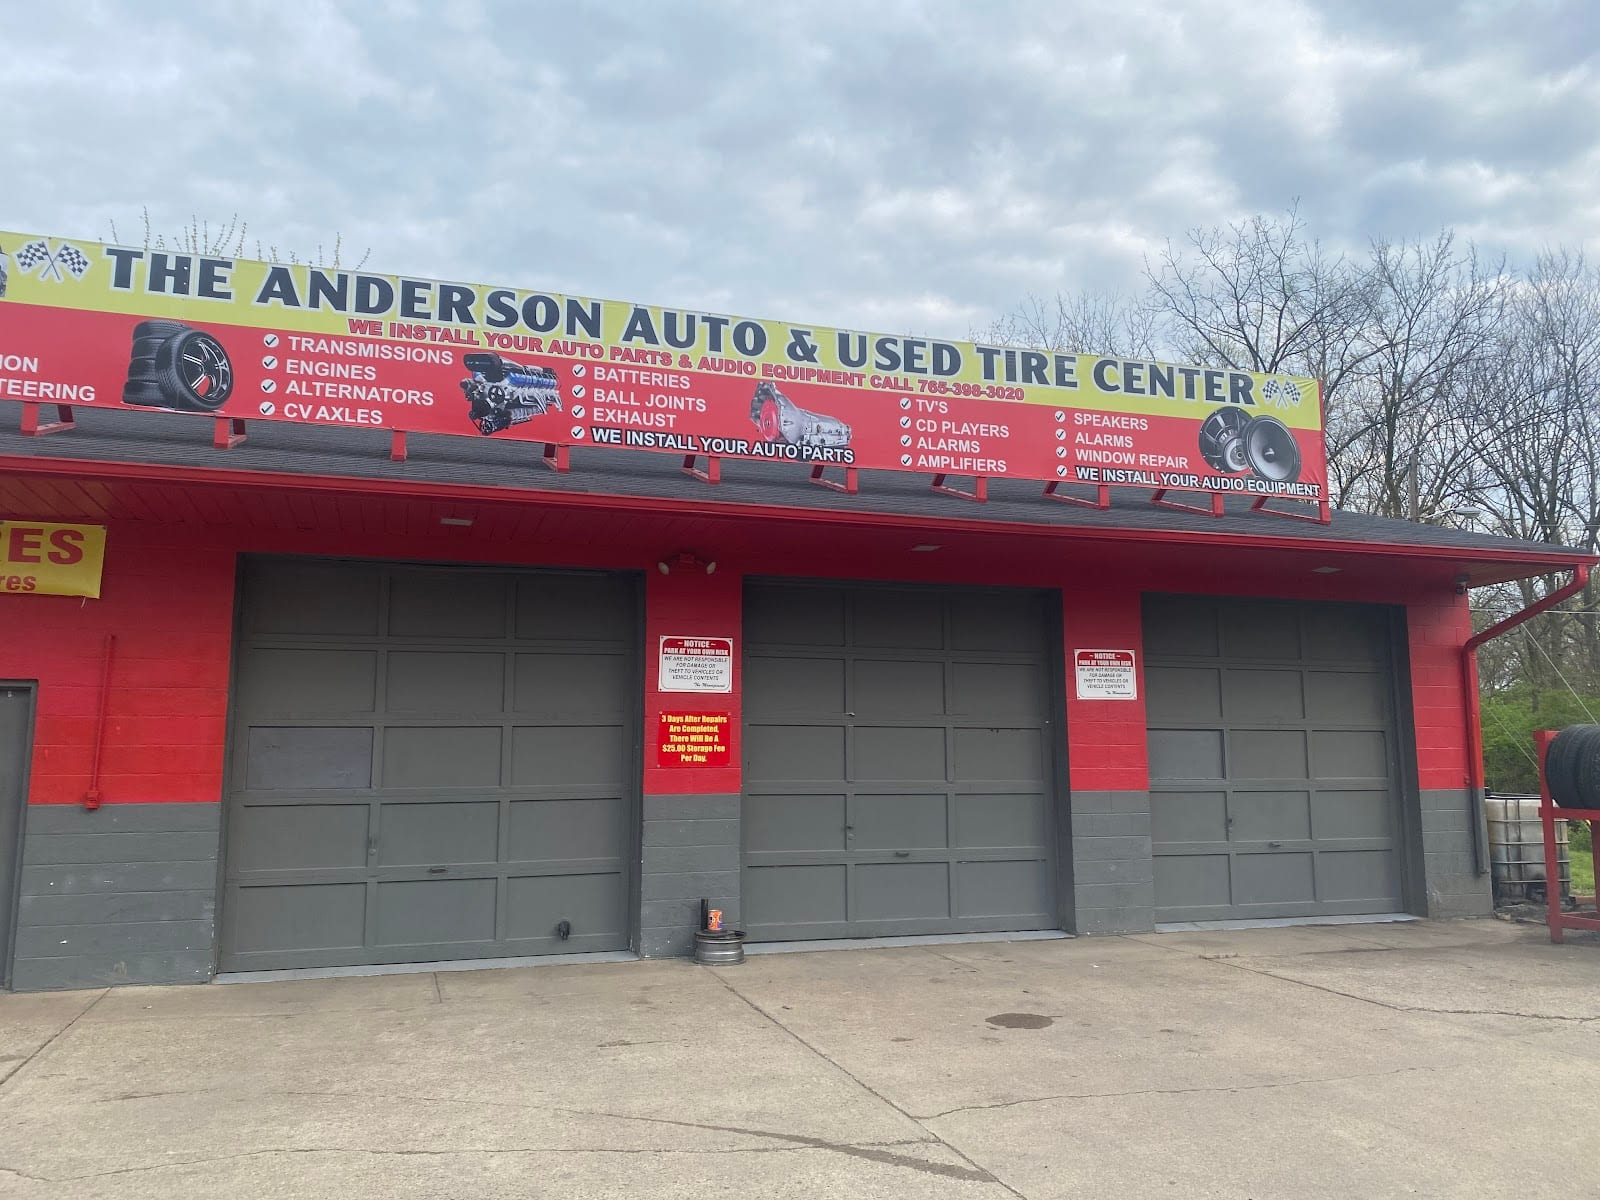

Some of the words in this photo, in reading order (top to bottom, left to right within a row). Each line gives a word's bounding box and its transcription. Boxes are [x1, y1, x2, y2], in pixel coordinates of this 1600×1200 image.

[106, 247, 233, 300] THE
[255, 266, 601, 339] ANDERSON
[622, 308, 767, 356] AUTO
[787, 329, 818, 363] &
[838, 332, 961, 377] USED
[977, 346, 1078, 389] TIRE
[1094, 359, 1255, 405] CENTER
[287, 335, 454, 365] TRANSMISSIONS
[348, 318, 383, 336] WE
[389, 322, 479, 346] INSTALL
[483, 331, 543, 353] YOUR
[549, 339, 604, 359] AUTO
[610, 346, 673, 367] PARTS
[678, 354, 693, 369] &
[698, 356, 757, 375] AUDIO
[762, 363, 866, 387] EQUIPMENT
[870, 374, 914, 392] CALL
[917, 379, 1025, 401] 765-398-3020
[285, 359, 377, 381] ENGINES
[593, 366, 691, 389] BATTERIES
[285, 380, 434, 406] ALTERNATORS
[593, 388, 640, 406] BALL
[645, 393, 707, 413] JOINTS
[283, 402, 313, 419] CV
[315, 405, 383, 425] AXLES
[915, 399, 948, 414] TV'S
[593, 406, 677, 429] EXHAUST
[915, 418, 938, 433] CD
[941, 421, 1010, 438] PLAYERS
[1074, 412, 1149, 431] SPEAKERS
[591, 427, 622, 445] WE
[626, 430, 698, 451] INSTALL
[700, 437, 749, 455] YOUR
[751, 443, 799, 460] AUTO
[802, 446, 855, 464] PARTS
[916, 436, 981, 454] ALARMS
[1075, 431, 1134, 448] ALARMS
[916, 454, 1008, 473] AMPLIFIERS
[1075, 448, 1137, 466] WINDOW
[1139, 452, 1189, 469] REPAIR
[1075, 466, 1100, 481] WE
[1102, 468, 1159, 485] INSTALL
[1160, 472, 1199, 488] YOUR
[1201, 475, 1244, 491] AUDIO
[1247, 479, 1321, 497] EQUIPMENT
[0, 527, 85, 565] ES
[683, 640, 710, 648] NOTICE
[667, 715, 684, 723] Days
[684, 715, 701, 723] After
[701, 715, 727, 723] Repairs
[669, 725, 681, 733] Are
[662, 744, 686, 752] $25.00
[686, 744, 713, 753] Storage
[680, 754, 693, 762] Per
[693, 754, 707, 763] Day.
